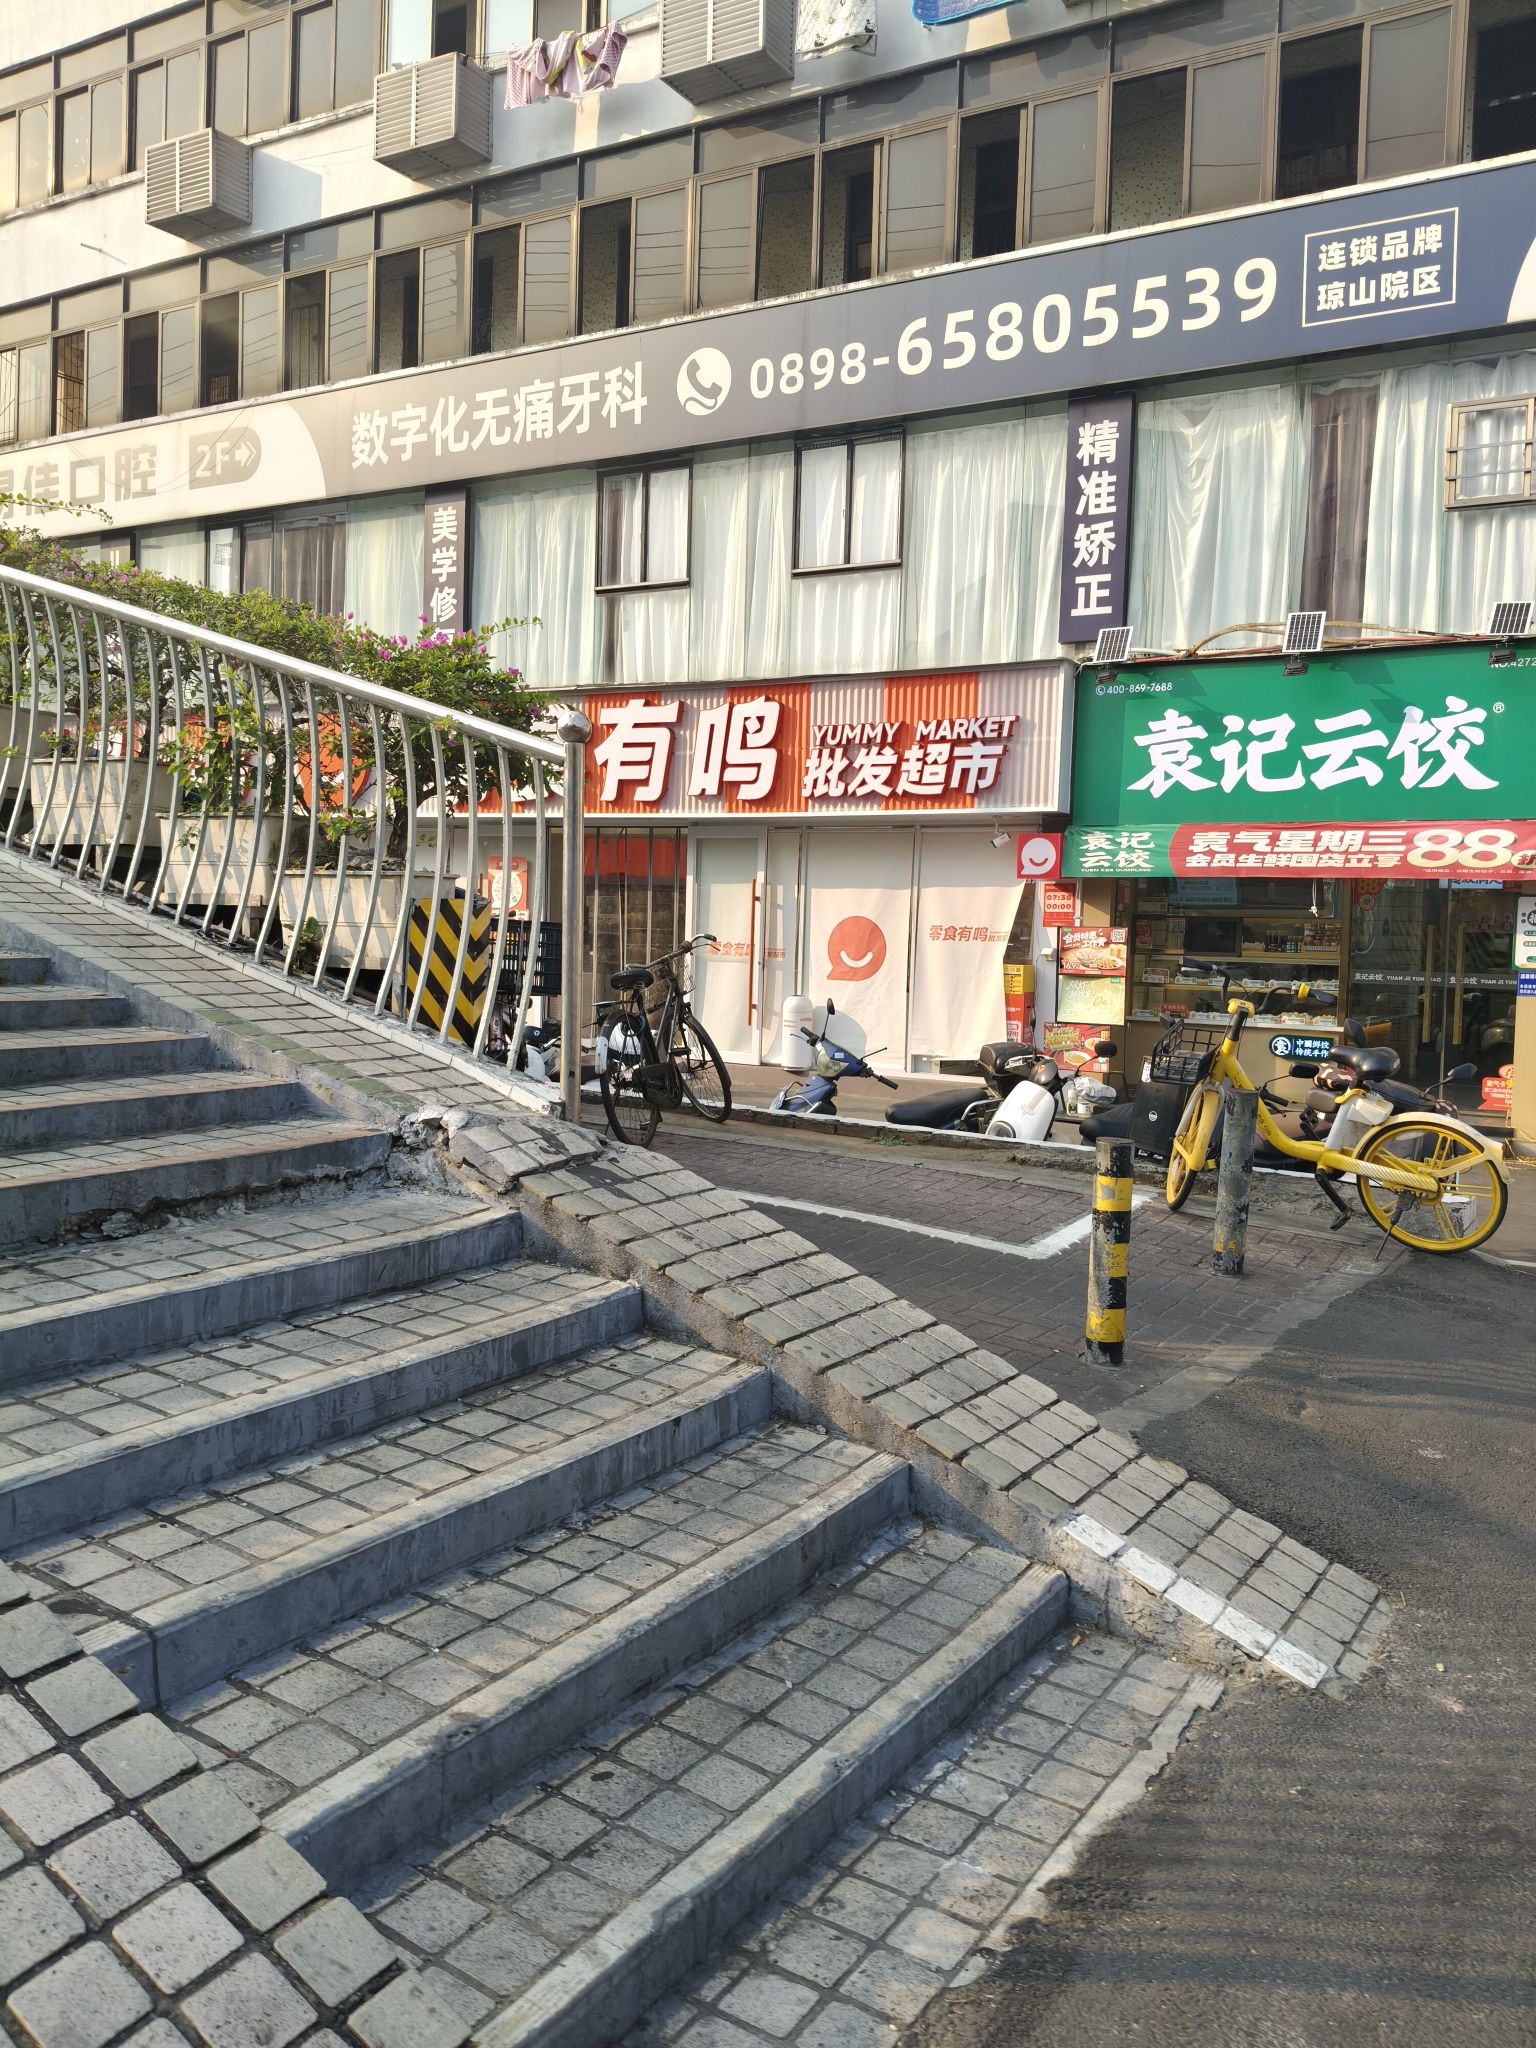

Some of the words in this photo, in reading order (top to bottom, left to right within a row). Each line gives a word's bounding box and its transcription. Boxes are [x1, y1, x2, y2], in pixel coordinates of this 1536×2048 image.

[1318, 224, 1443, 272] 连锁品牌
[1317, 265, 1441, 312] 琼山院区
[750, 257, 1277, 399] 0898-65805539
[351, 361, 648, 470] 数字化无痛牙科
[196, 440, 230, 478] 2F
[1071, 420, 1119, 617] 精准矫正
[1107, 682, 1173, 694] 400-869-7688
[812, 722, 900, 746] YUMMY
[915, 715, 1019, 742] MARKET
[1127, 695, 1500, 798] 袁记云饺
[802, 742, 1006, 798] 批发超市
[1079, 850, 1154, 868] 云饺
[1080, 831, 1156, 850] 袁记
[1189, 830, 1408, 853] 袁气星期三
